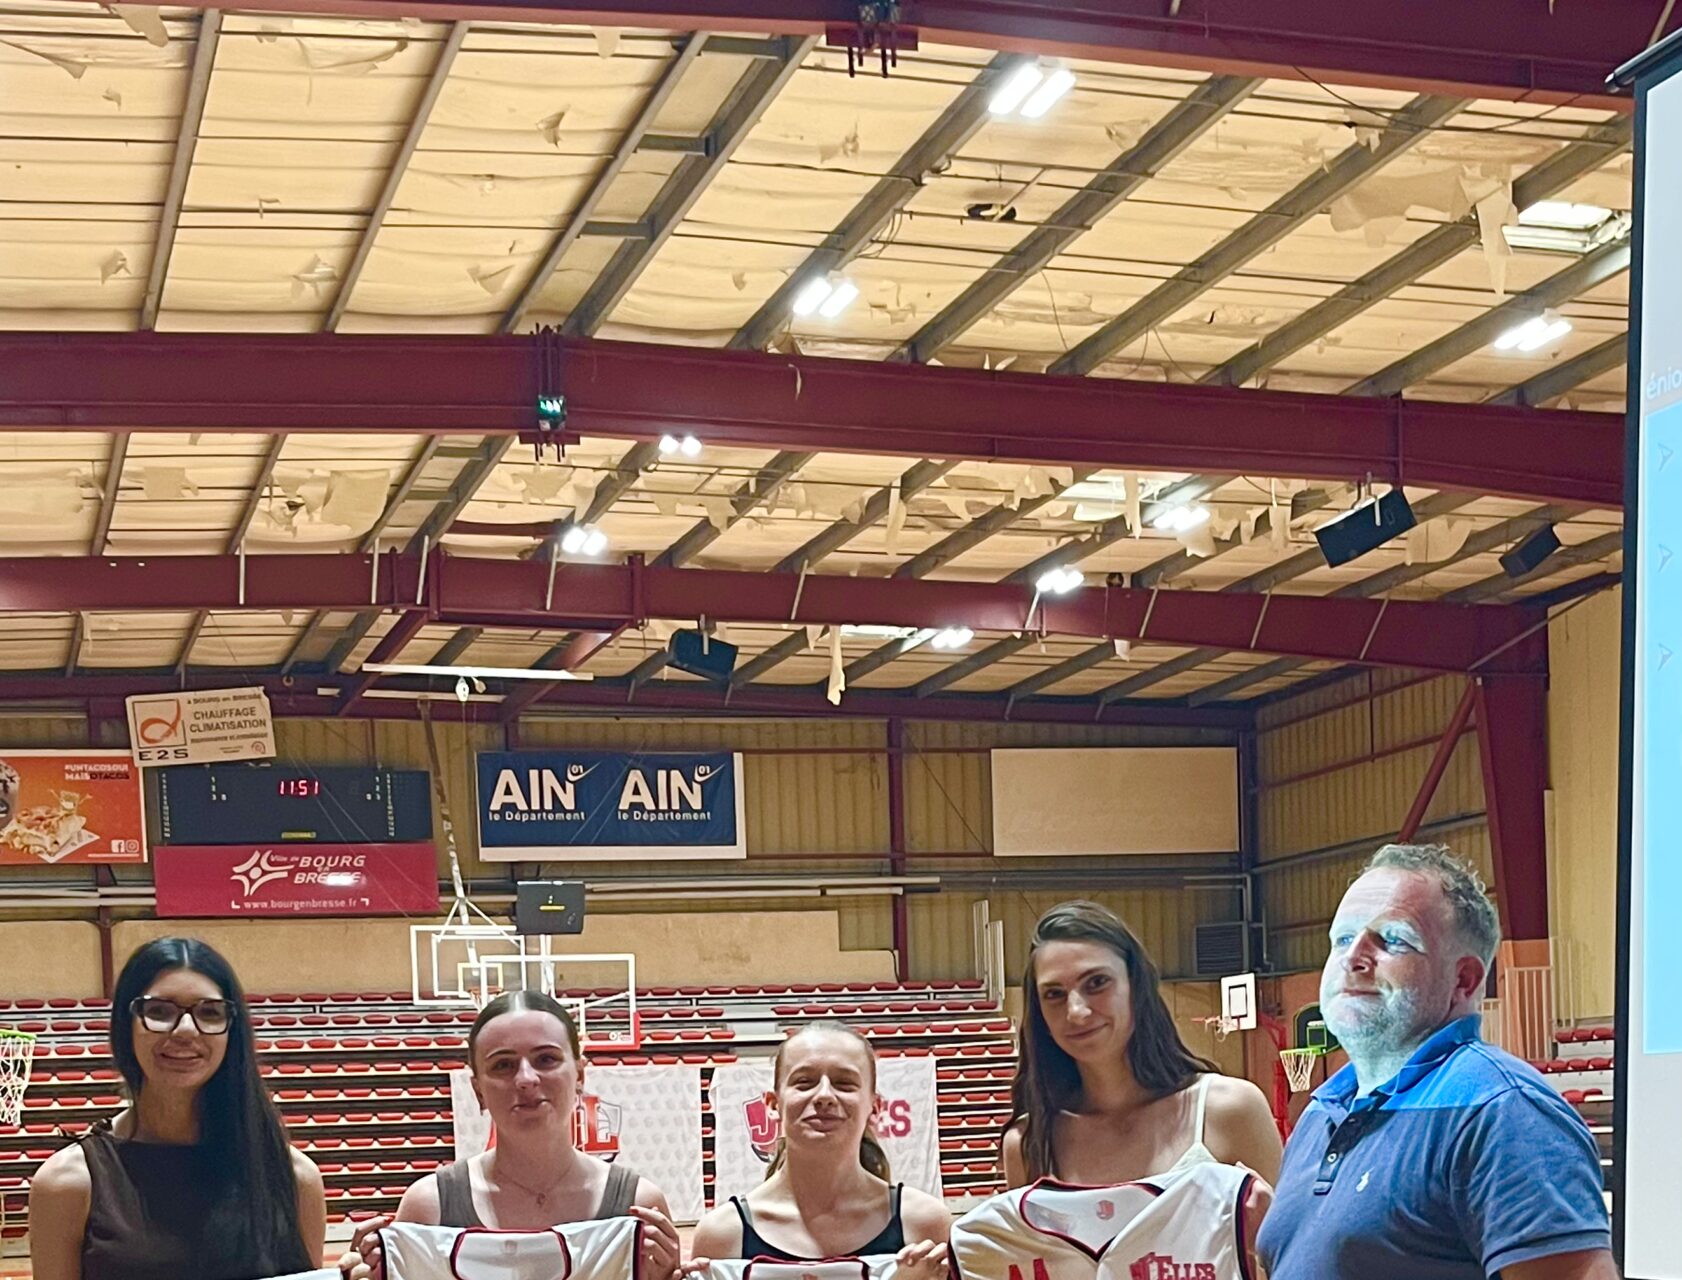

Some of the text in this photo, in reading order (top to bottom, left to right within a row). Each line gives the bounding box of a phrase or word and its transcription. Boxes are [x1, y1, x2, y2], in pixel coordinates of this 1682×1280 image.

[193, 706, 256, 721] CHAUFFAGE
[189, 719, 267, 733] CLIMATISATION
[139, 748, 189, 761] E2S
[489, 764, 584, 811] AIN 01
[618, 765, 711, 810] AIN 01
[488, 811, 586, 823] le Département
[617, 810, 712, 823] le Département
[299, 855, 366, 868] BOURG
[243, 898, 357, 911] www.bourgenbresse.fr
